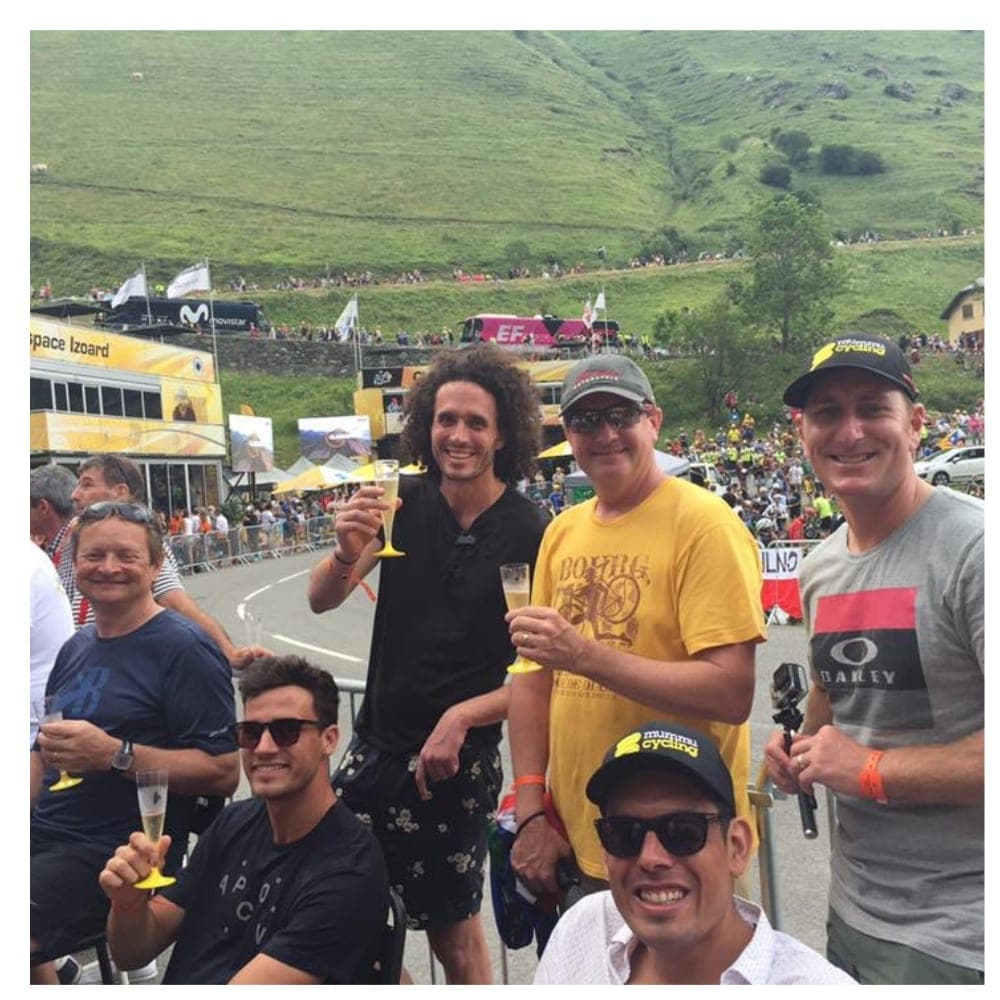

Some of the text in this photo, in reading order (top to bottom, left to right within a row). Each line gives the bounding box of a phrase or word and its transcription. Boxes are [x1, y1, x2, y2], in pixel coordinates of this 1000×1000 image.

[70, 336, 110, 358] Izoard
[642, 738, 699, 758] cycling
[643, 730, 698, 748] mummu
